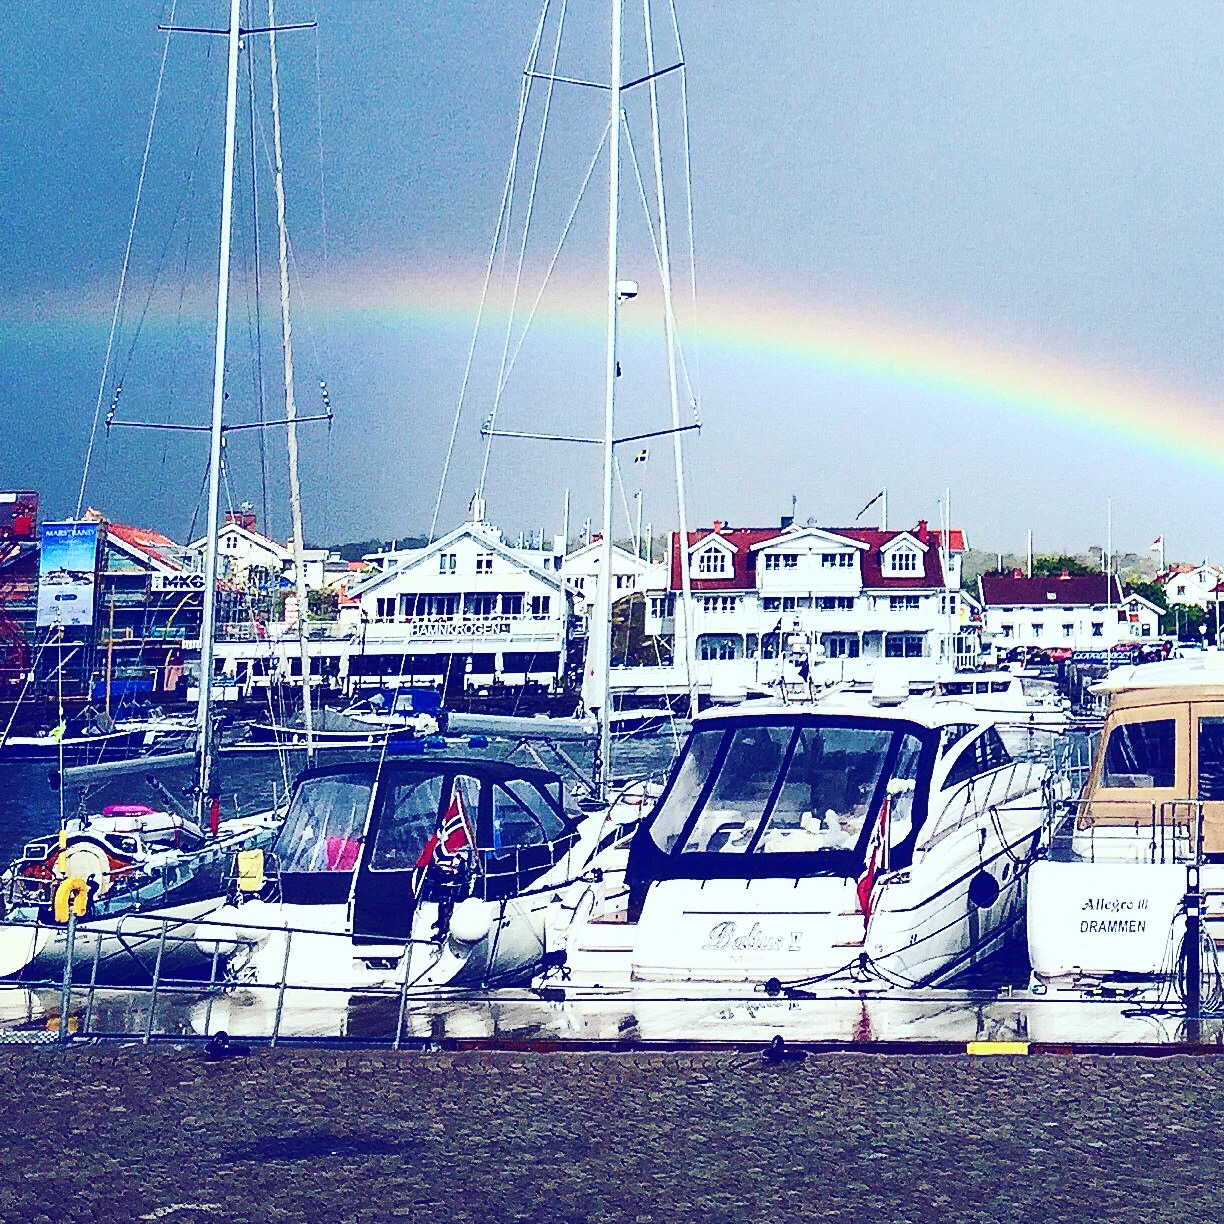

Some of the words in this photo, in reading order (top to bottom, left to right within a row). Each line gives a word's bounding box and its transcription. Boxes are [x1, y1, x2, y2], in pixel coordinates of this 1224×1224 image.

[410, 623, 502, 636] HAMNKROGEN
[1081, 898, 1134, 913] Allegro
[1080, 920, 1146, 933] DRAMMEN
